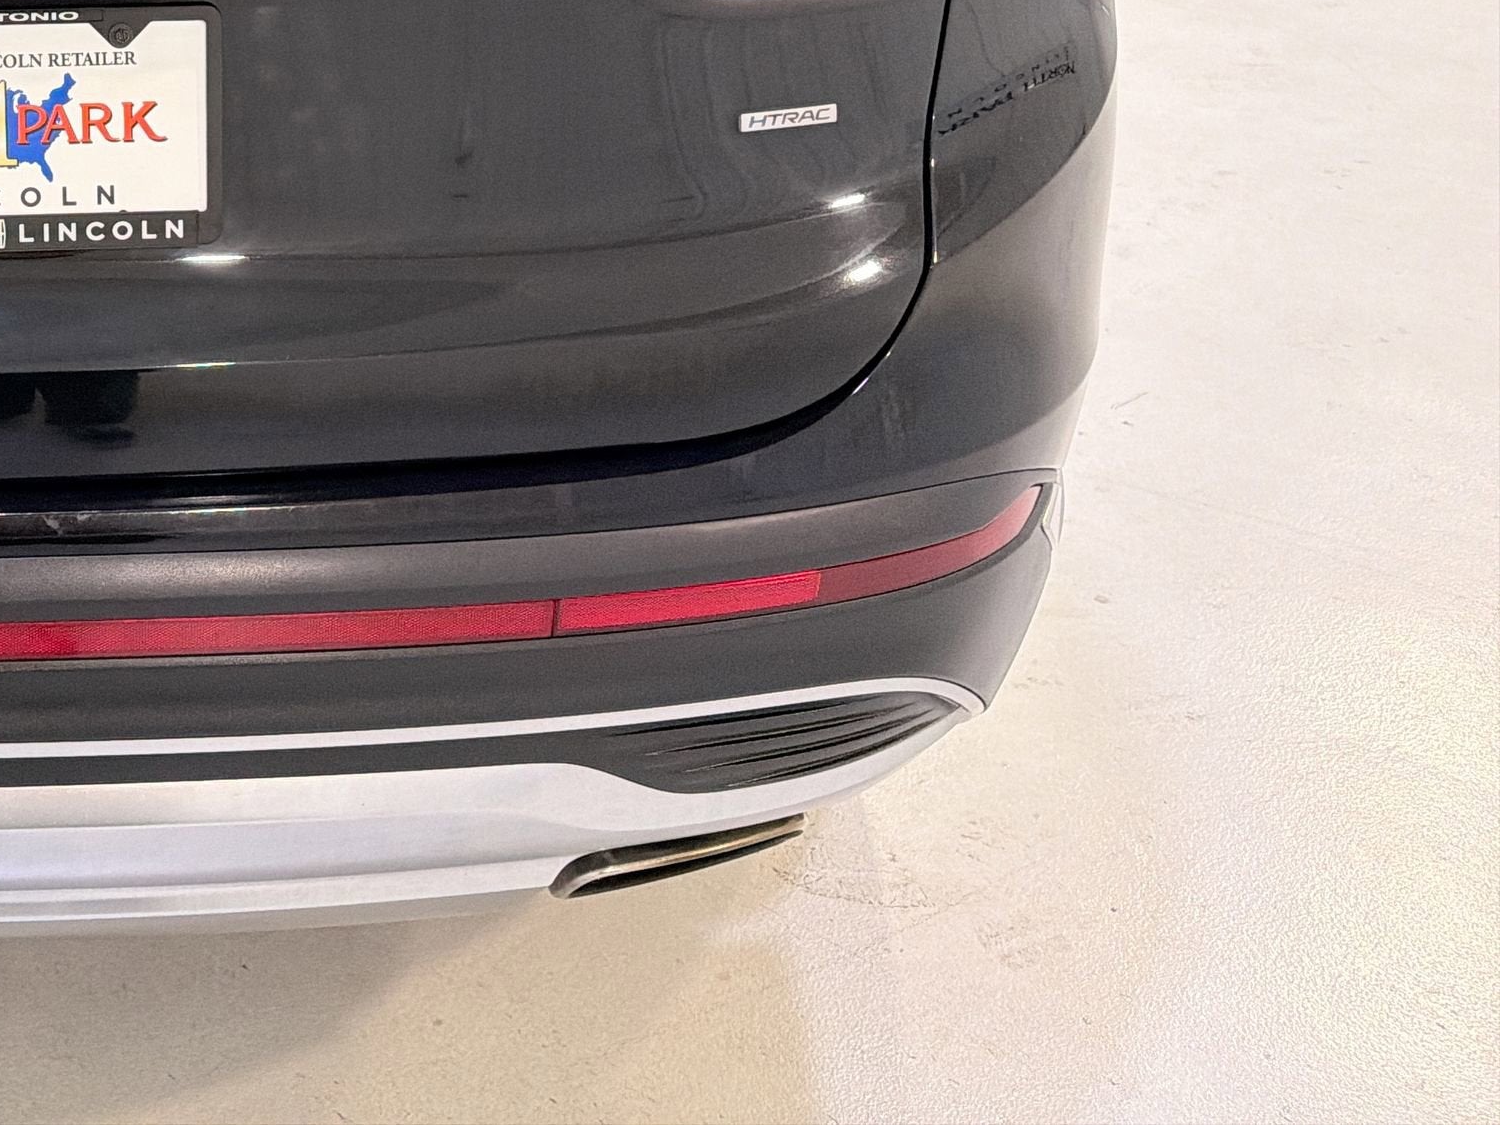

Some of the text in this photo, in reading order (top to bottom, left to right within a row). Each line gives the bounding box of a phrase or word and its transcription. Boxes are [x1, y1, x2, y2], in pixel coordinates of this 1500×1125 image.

[48, 50, 137, 67] RETAILER
[16, 100, 168, 145] PARK
[748, 108, 831, 129] HTRAC
[19, 219, 185, 243] LINCOLN
